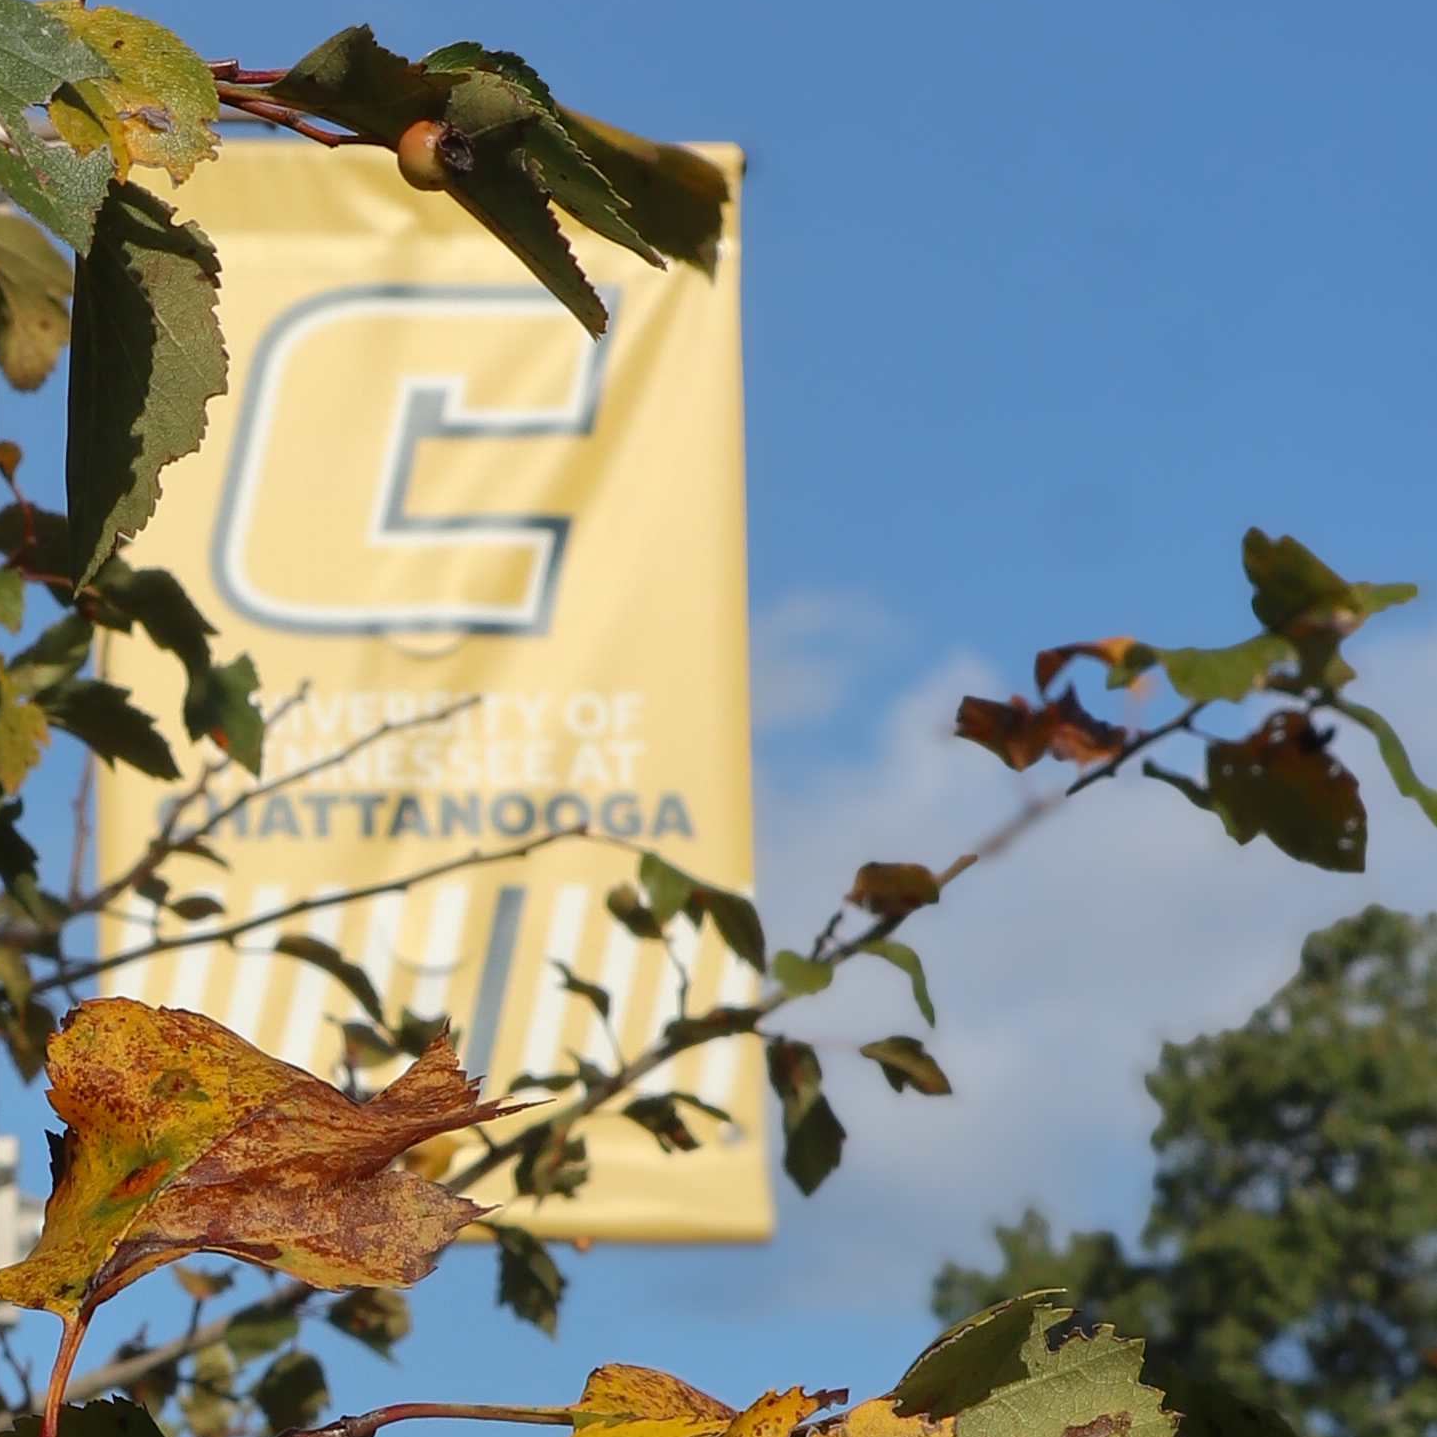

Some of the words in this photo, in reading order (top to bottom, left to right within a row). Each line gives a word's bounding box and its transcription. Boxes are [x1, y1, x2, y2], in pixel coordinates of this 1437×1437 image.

[210, 284, 621, 636] C
[564, 690, 643, 737] OF
[569, 742, 645, 786] AT
